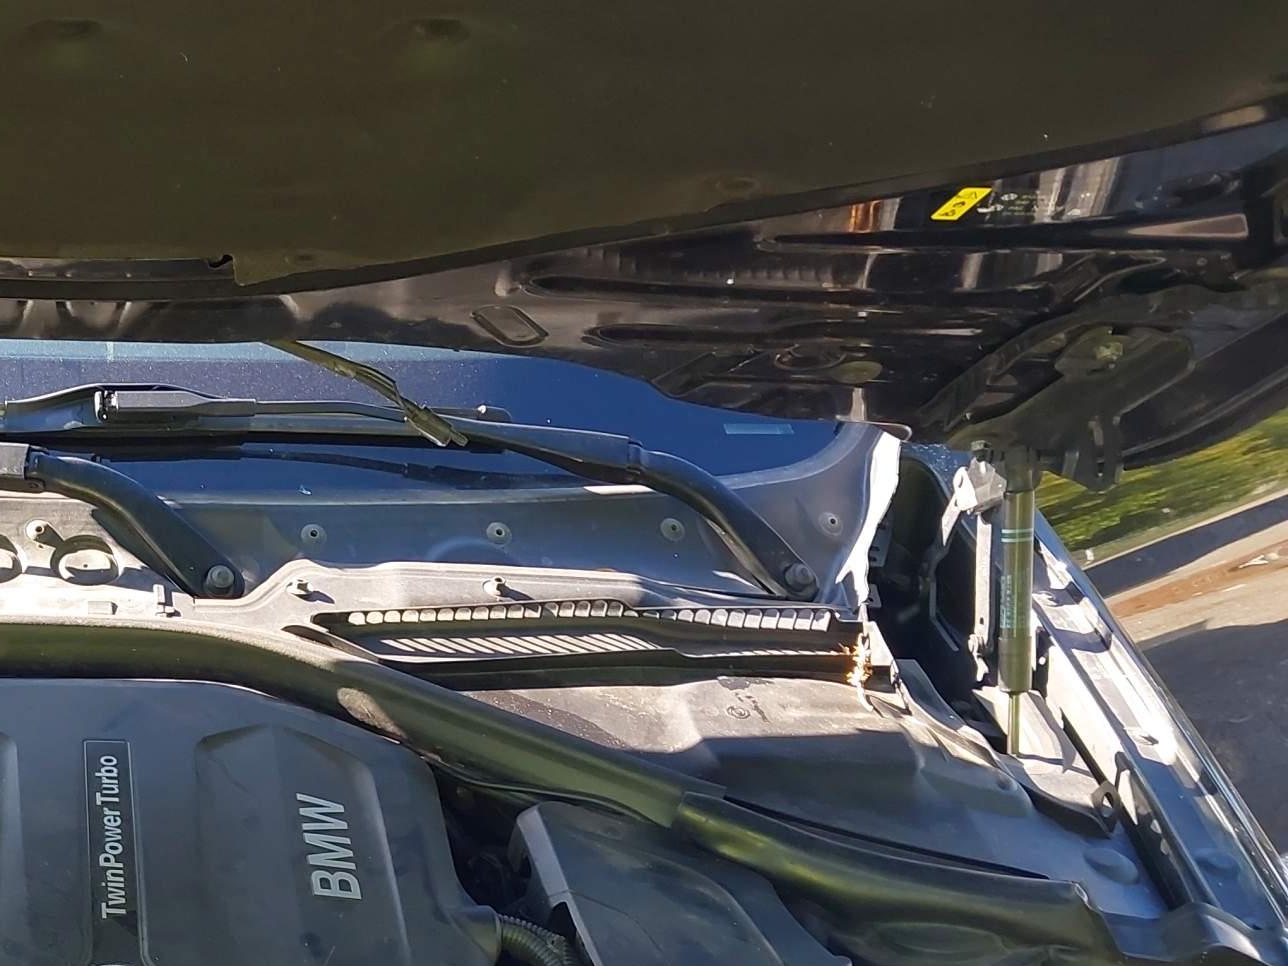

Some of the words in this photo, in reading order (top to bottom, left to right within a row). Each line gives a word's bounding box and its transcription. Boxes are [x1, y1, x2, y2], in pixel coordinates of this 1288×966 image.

[95, 755, 120, 805] Turbo
[99, 807, 127, 919] TwinPower
[296, 792, 362, 900] BMW
